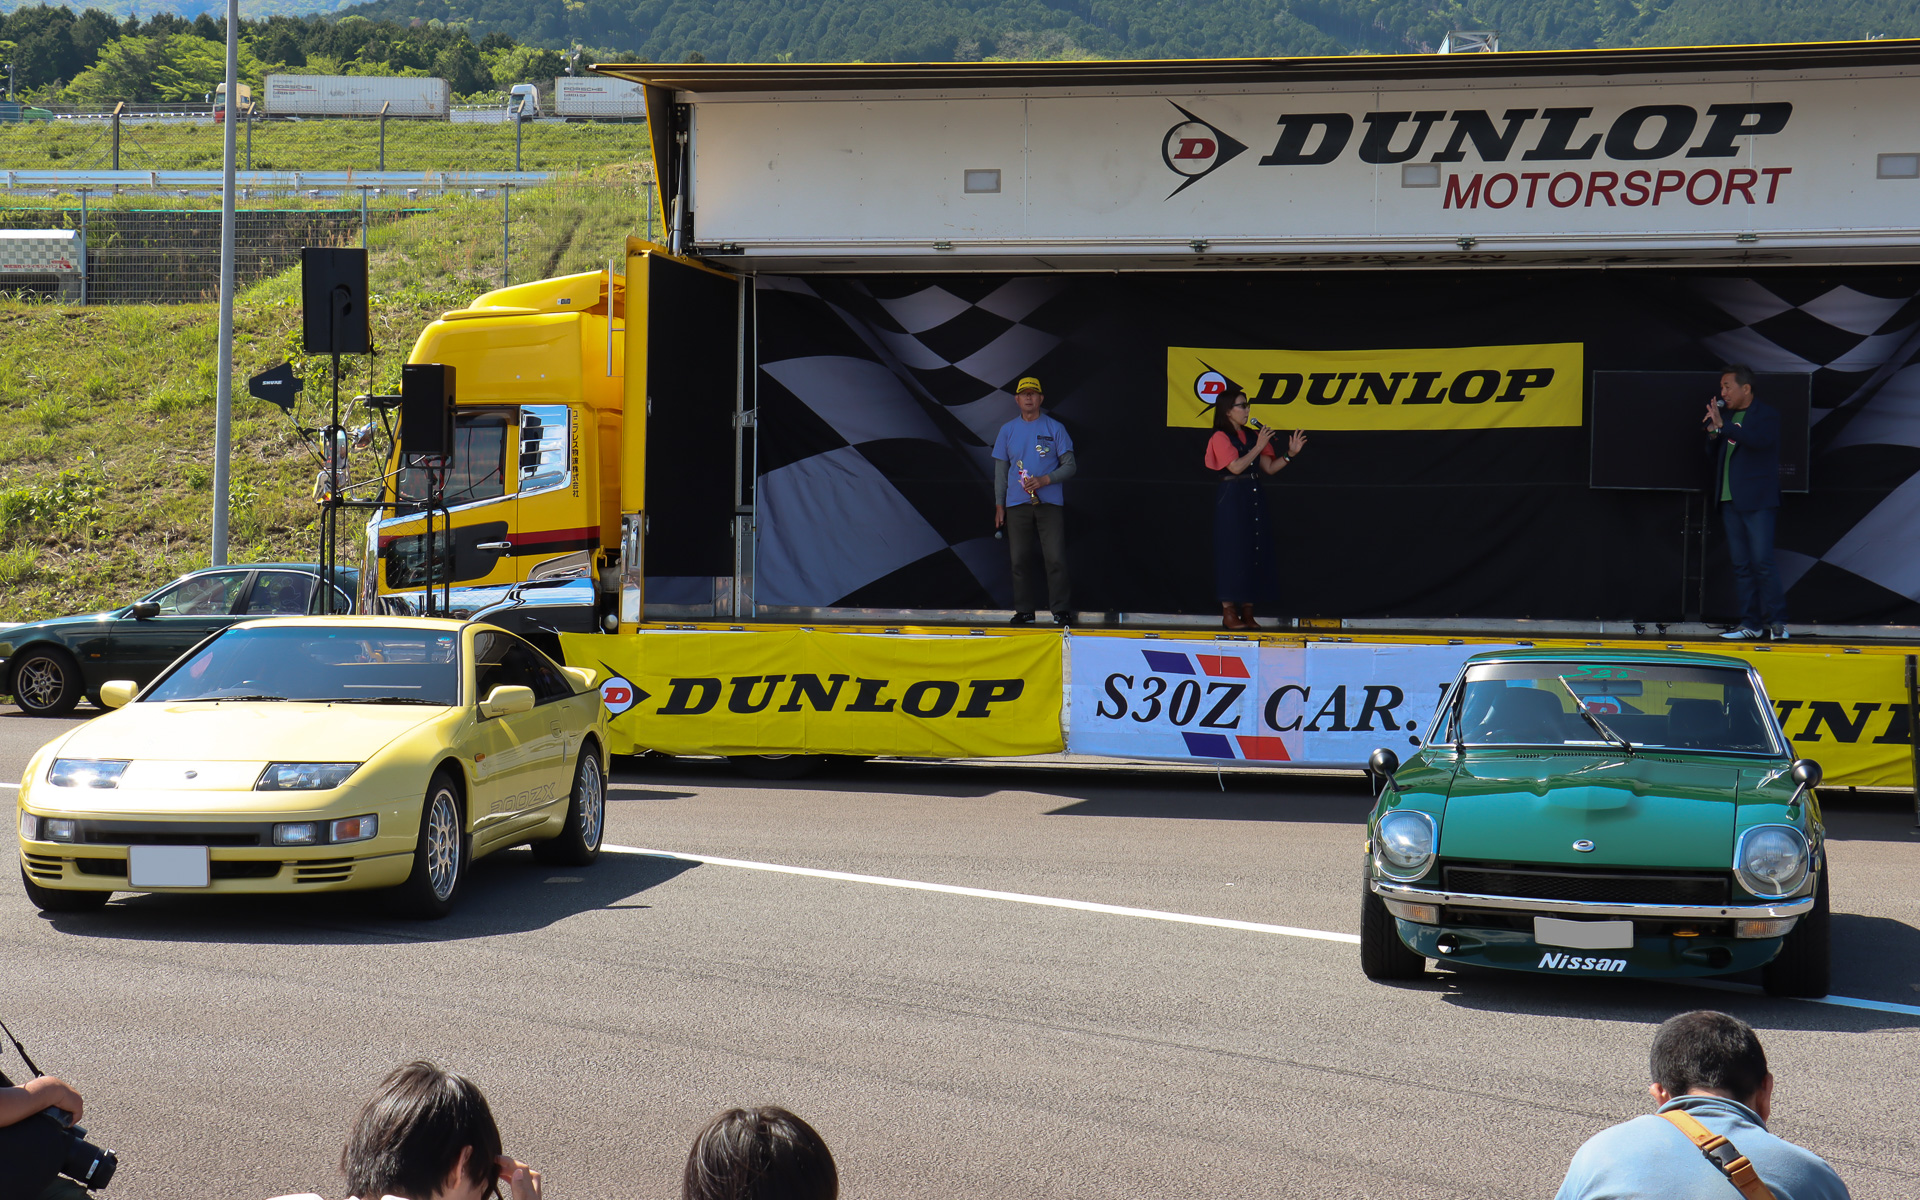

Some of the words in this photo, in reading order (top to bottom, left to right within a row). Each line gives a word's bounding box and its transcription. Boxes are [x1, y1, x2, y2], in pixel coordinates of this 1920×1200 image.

[1174, 138, 1216, 159] D
[1258, 102, 1793, 165] DUNLOP
[1444, 168, 1792, 209] MOTORSPORT
[1200, 381, 1225, 395] D
[1249, 368, 1555, 405] DUNLOP
[603, 687, 631, 703] D
[656, 673, 1025, 718] DUNLOP
[1096, 672, 1247, 730] S30Z
[489, 782, 556, 813] 300ZX
[1537, 952, 1627, 973] Nissan
